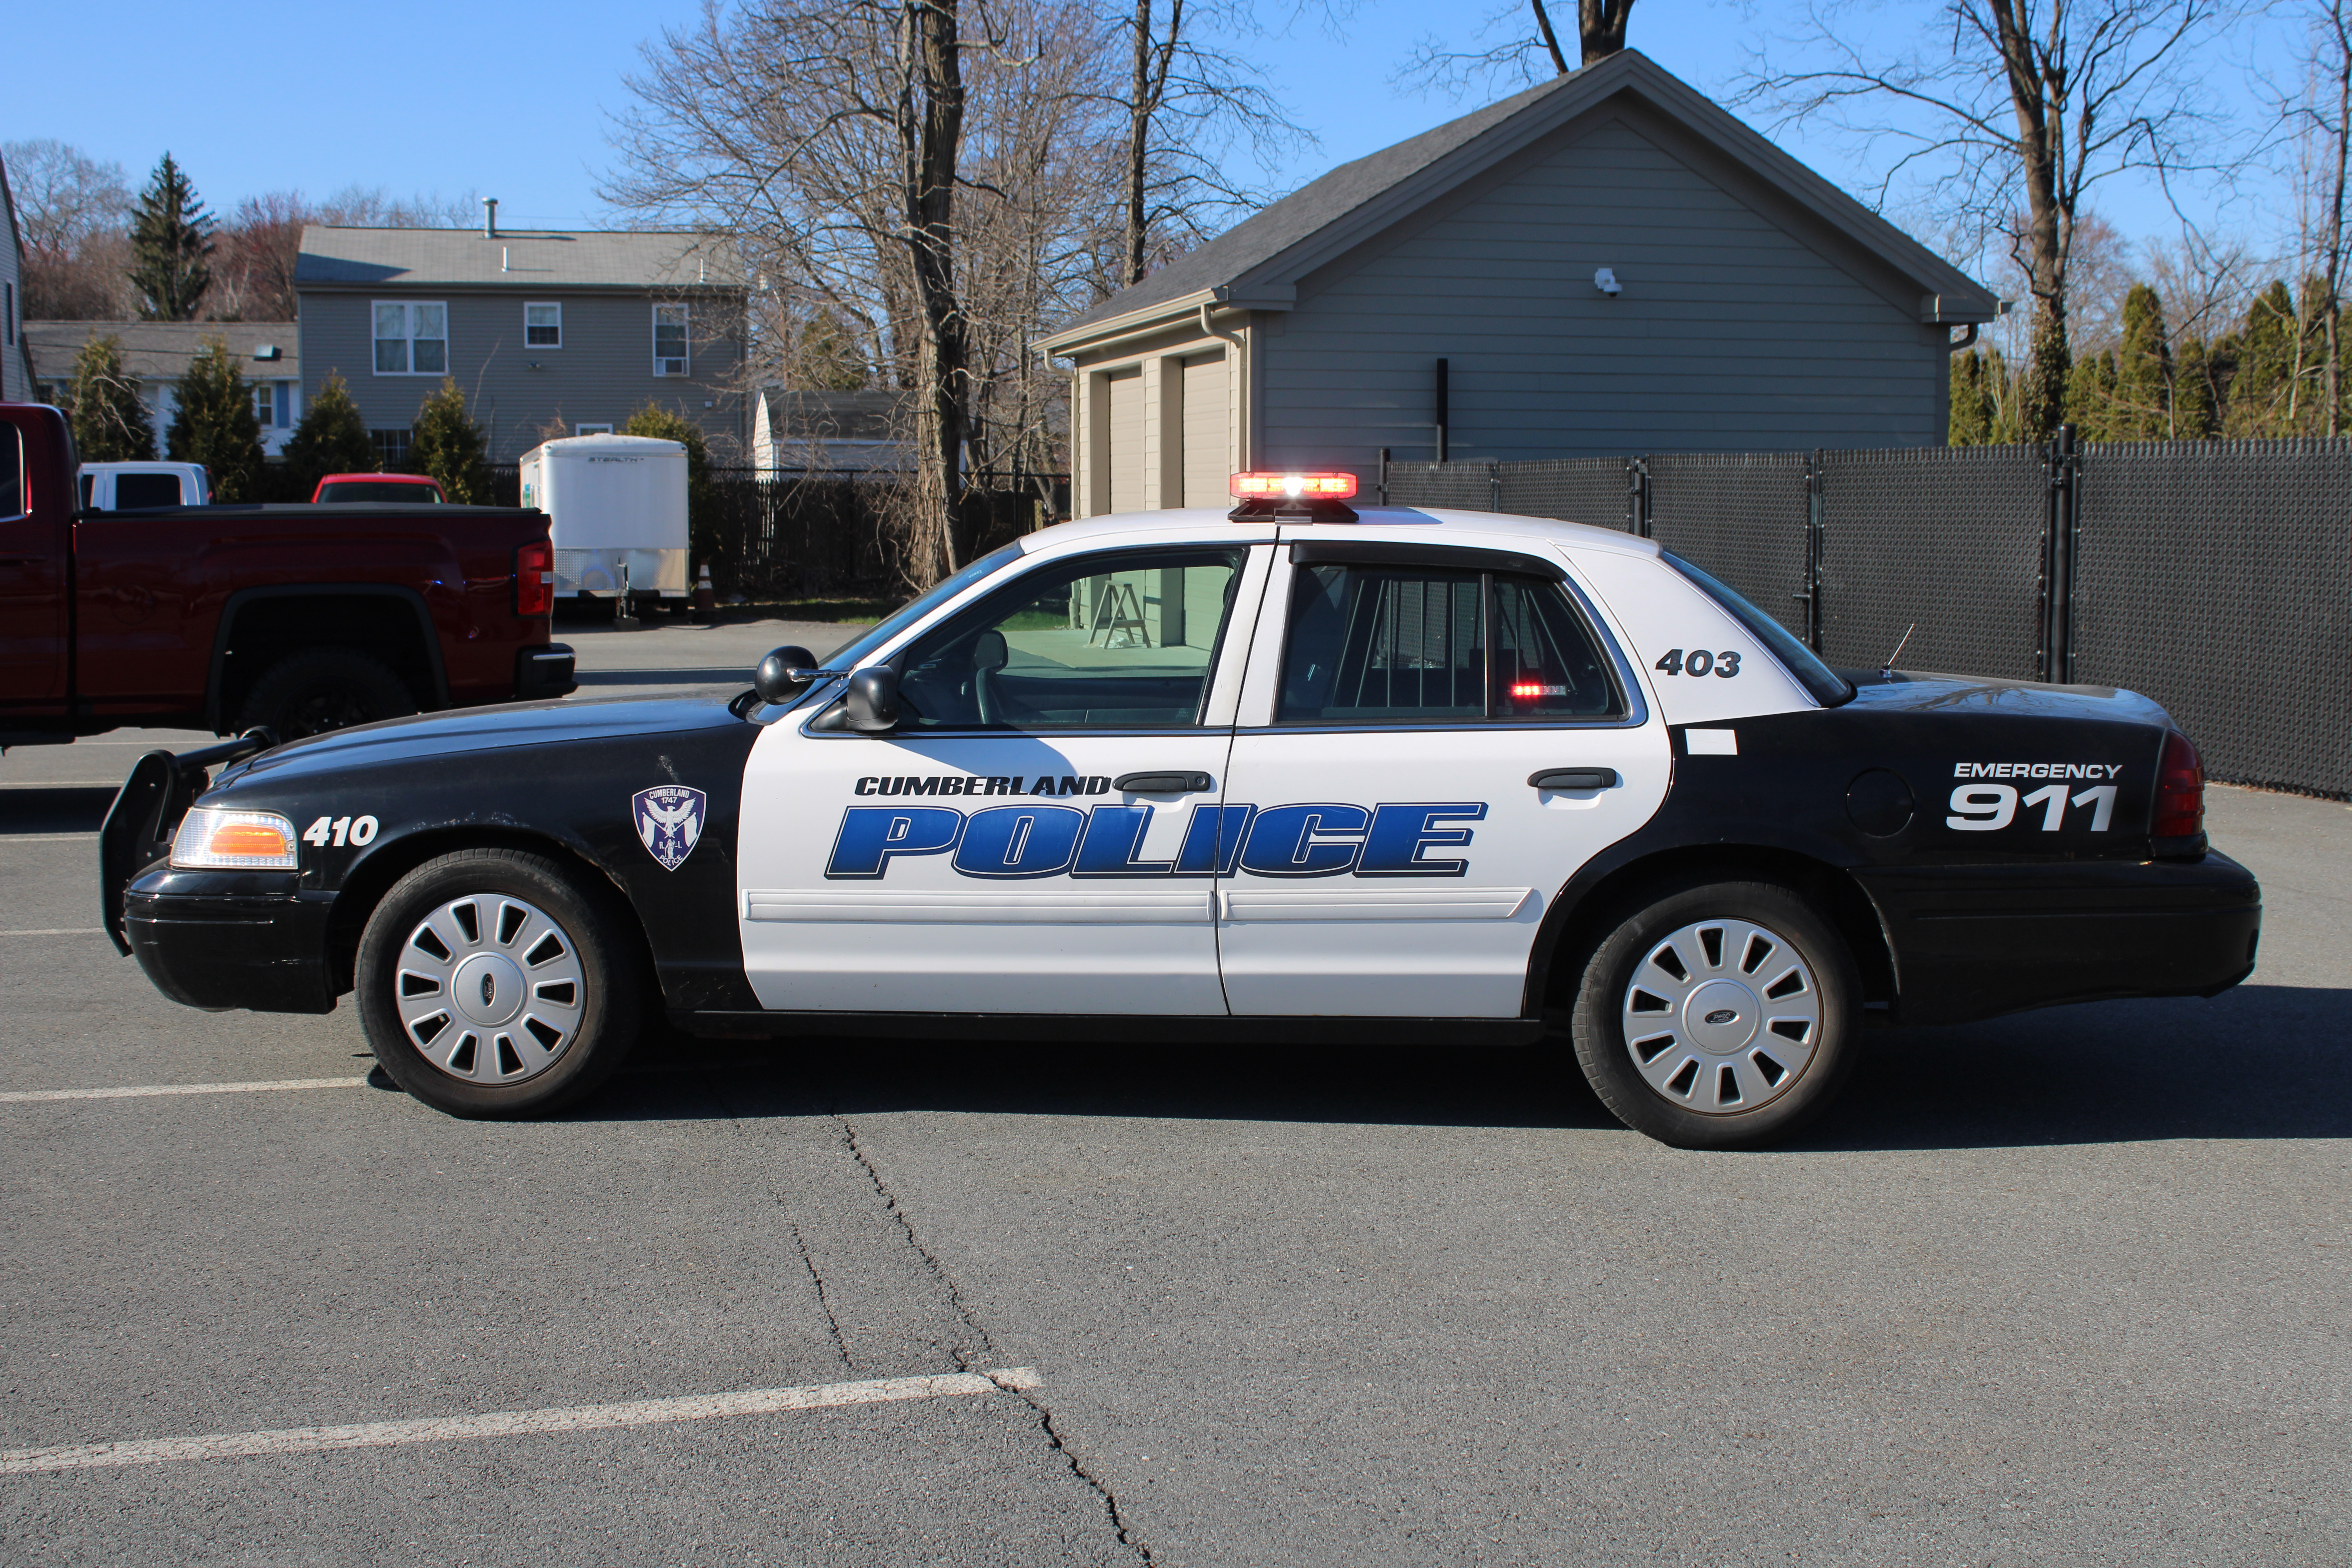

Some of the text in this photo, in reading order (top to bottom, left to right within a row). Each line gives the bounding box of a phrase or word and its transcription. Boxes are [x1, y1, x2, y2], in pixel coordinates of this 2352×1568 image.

[1655, 649, 1741, 678] 403
[1954, 763, 2123, 779] EMERGENCY
[649, 788, 690, 799] CUMBERLAND
[855, 776, 1112, 796] CUMBERLAND
[1946, 784, 2117, 831] 911
[303, 815, 379, 847] 410
[823, 802, 1488, 880] POLICE
[659, 855, 683, 866] POLICE
